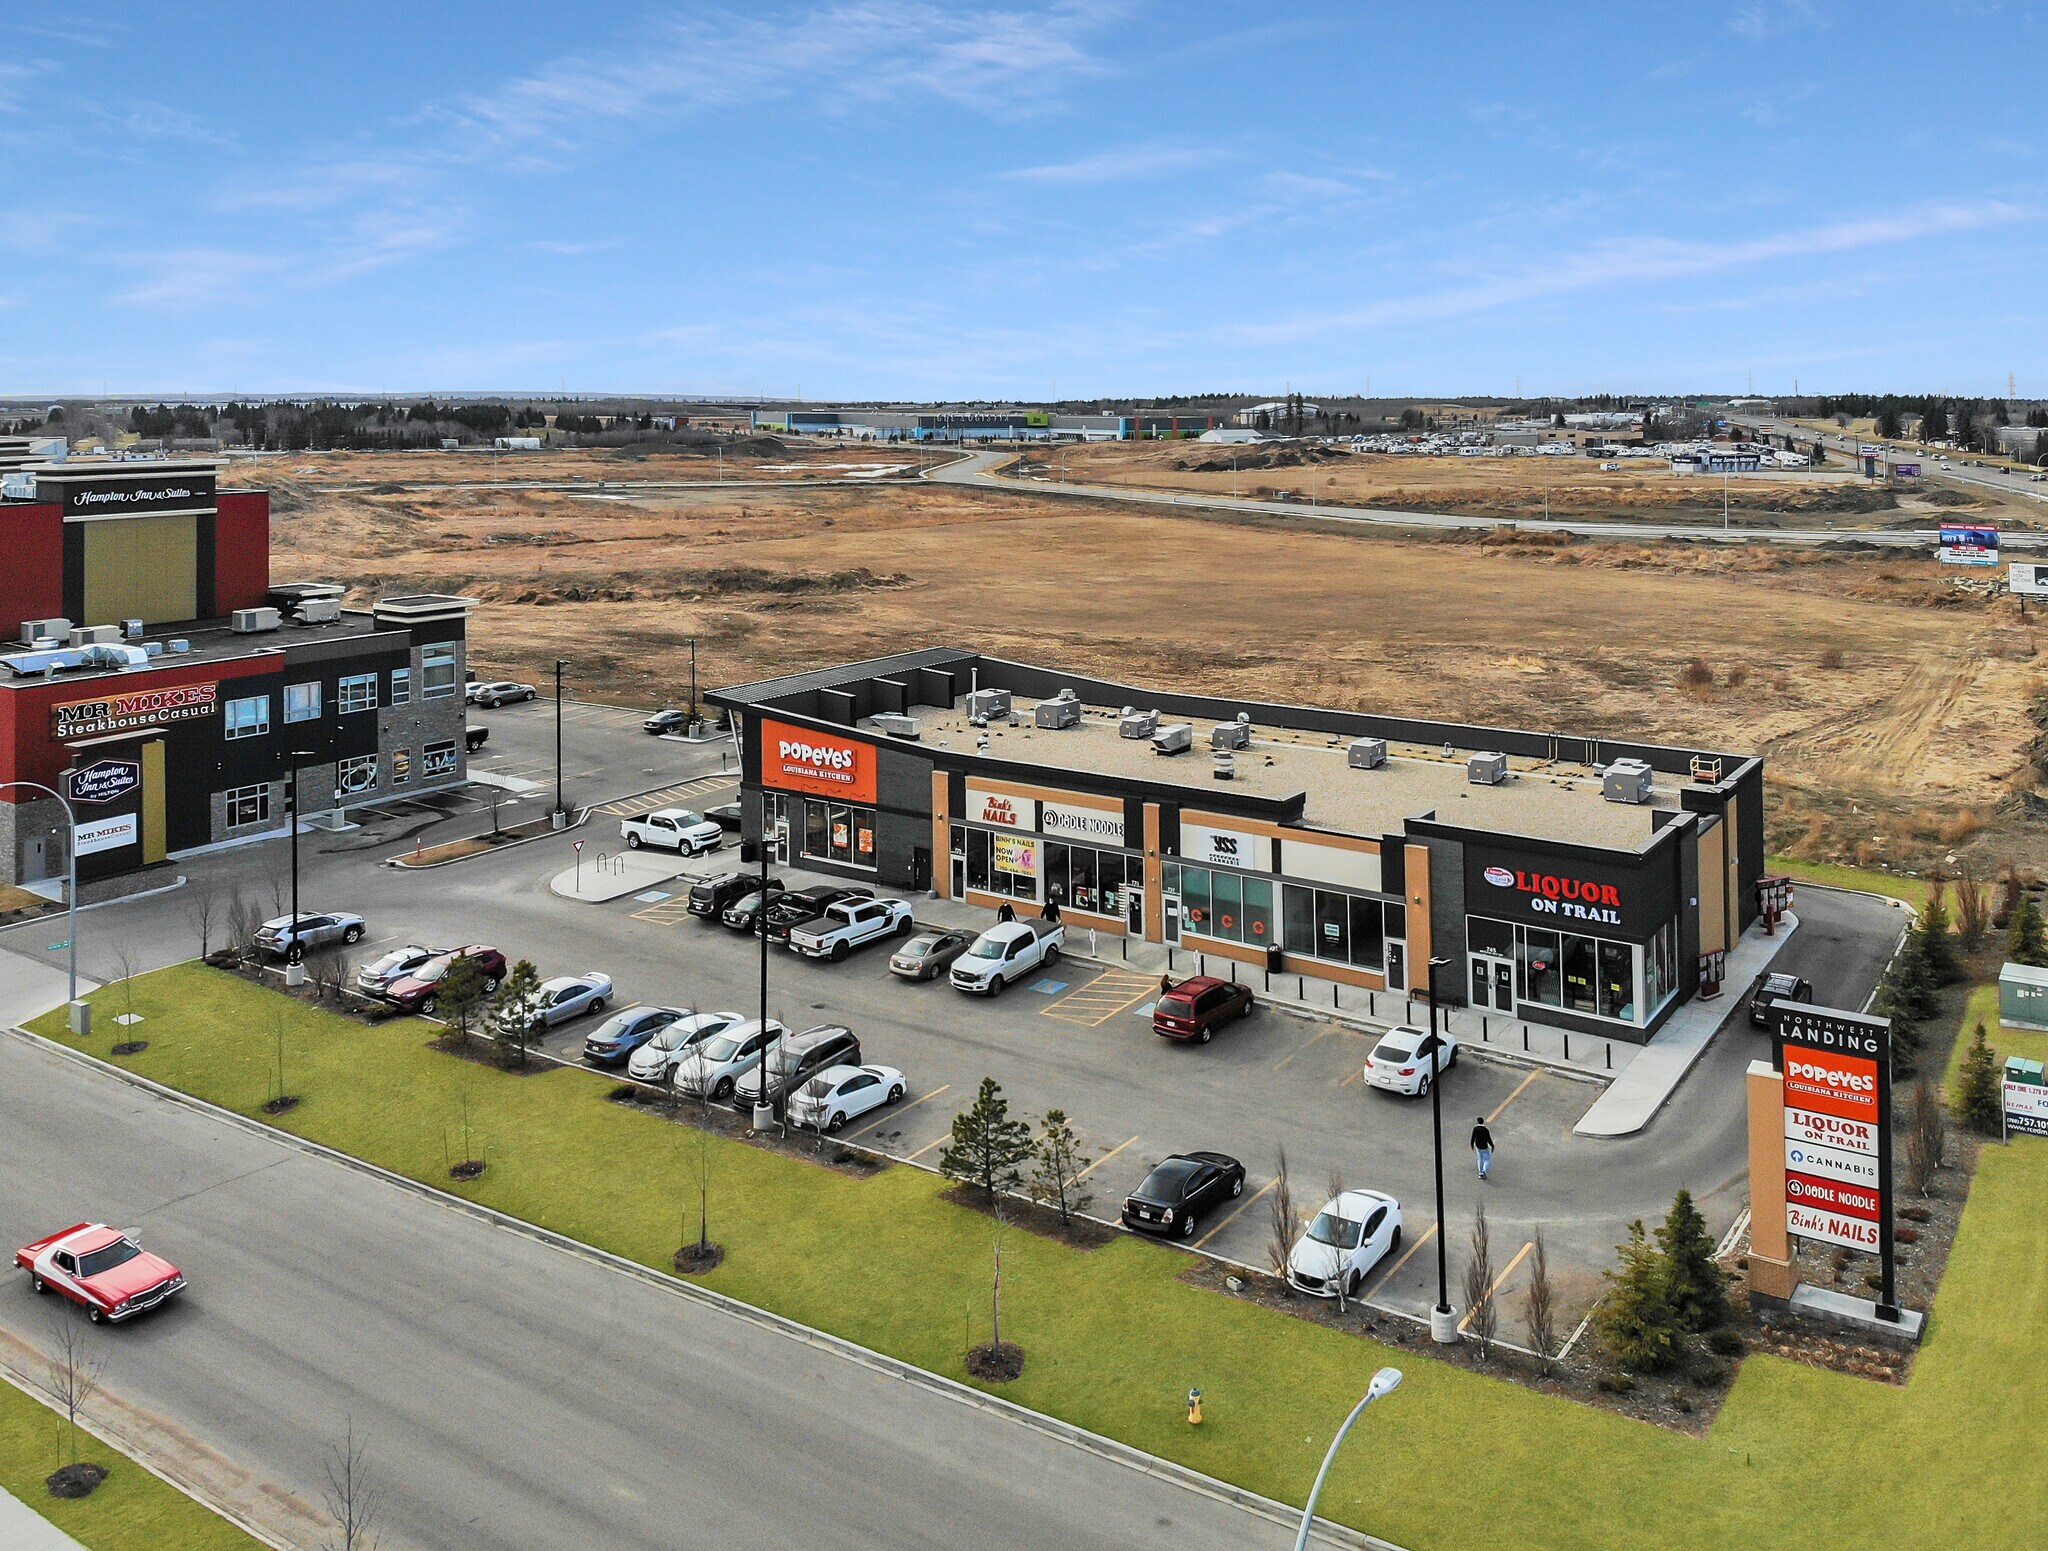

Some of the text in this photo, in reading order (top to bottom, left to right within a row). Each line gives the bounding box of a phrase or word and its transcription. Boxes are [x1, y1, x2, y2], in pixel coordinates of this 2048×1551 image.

[74, 490, 129, 505] Hampton
[130, 490, 157, 501] Inn
[162, 488, 190, 498] Suites
[58, 685, 216, 724] MR MIKES
[78, 767, 129, 784] Hampton
[783, 765, 850, 782] LOUISIANA KITCHEN
[76, 783, 101, 795] Inn
[107, 776, 133, 787] Suites
[987, 796, 1011, 811] Binh's
[982, 808, 1018, 825] NAILS
[77, 824, 132, 841] MR MIKES
[1089, 818, 1124, 837] NOODLE
[996, 846, 1013, 855] NOW
[996, 855, 1014, 864] OPEN
[1210, 856, 1239, 866] CANNABIS
[1516, 870, 1621, 907] LIQUOR
[1531, 898, 1621, 925] ON TRAIL
[1783, 1015, 1873, 1036] NORTHWEST
[1780, 1023, 1877, 1052] LANDING
[1789, 1082, 1871, 1103] LOUISIANA KITCHEN
[2007, 1102, 2033, 1110] RE/MAX
[1793, 1112, 1870, 1139] LIQUOR
[1804, 1130, 1869, 1150] ON TRAIL
[1807, 1155, 1874, 1176] CANNABIS
[1838, 1192, 1875, 1210] NOODLE
[1788, 1210, 1878, 1244] Binh's NAILS
